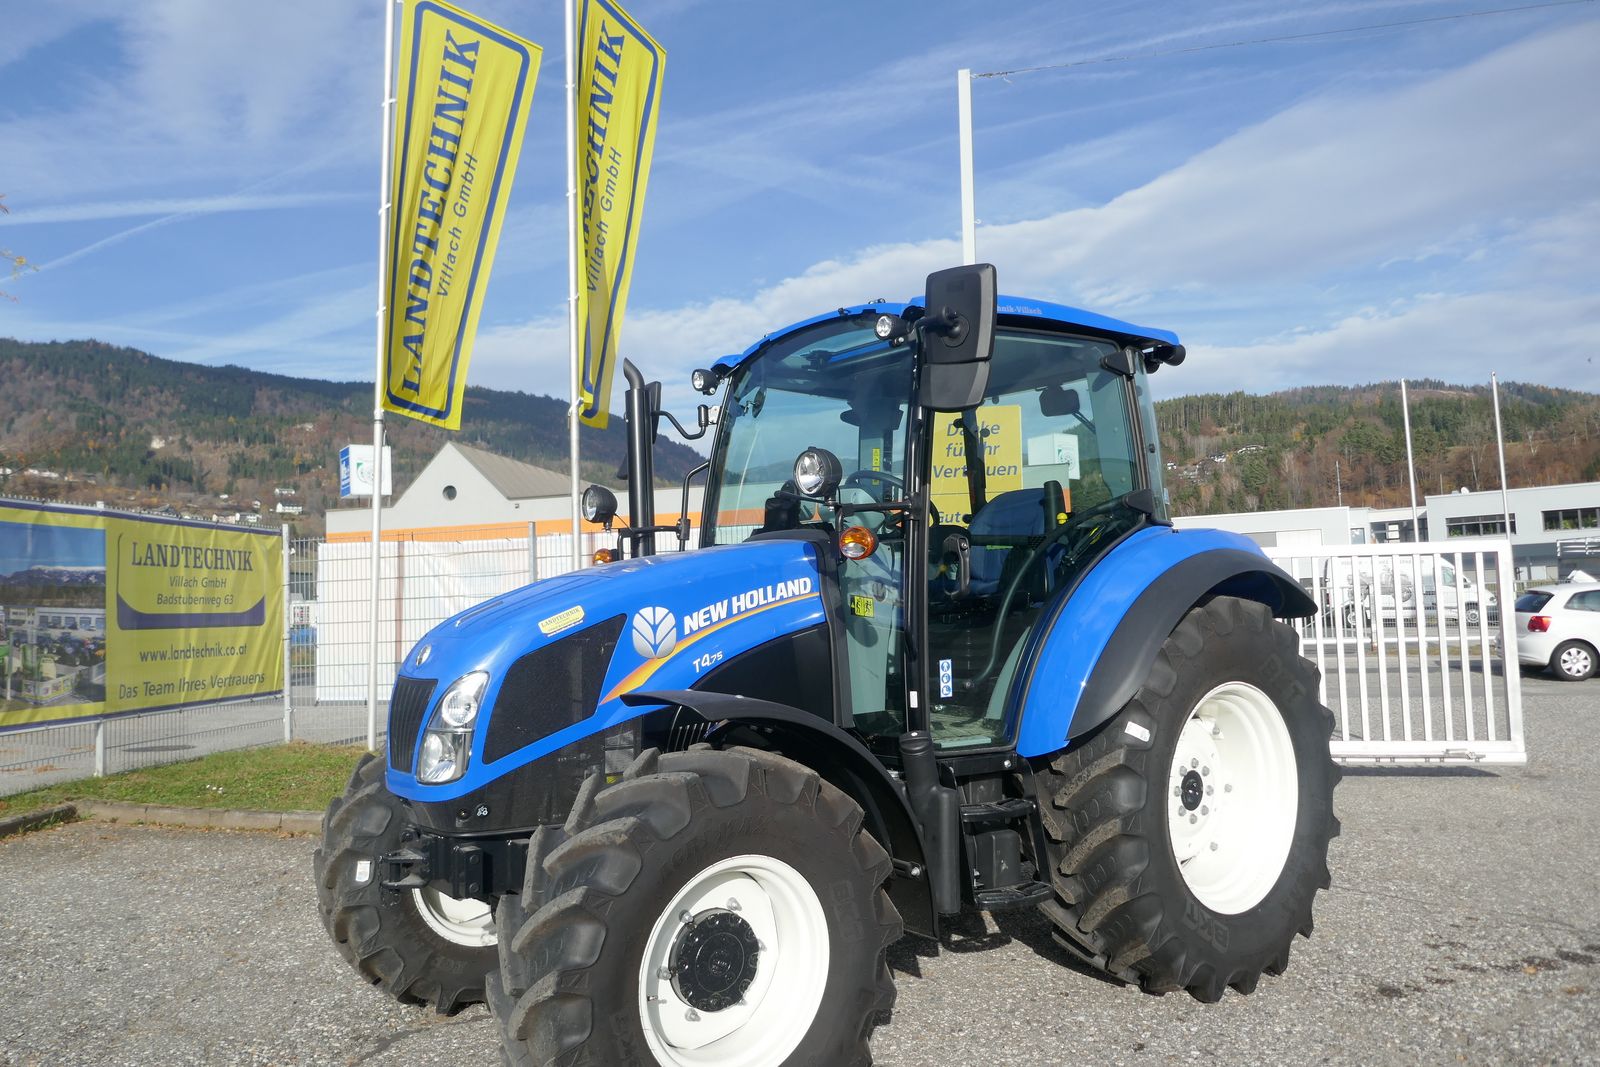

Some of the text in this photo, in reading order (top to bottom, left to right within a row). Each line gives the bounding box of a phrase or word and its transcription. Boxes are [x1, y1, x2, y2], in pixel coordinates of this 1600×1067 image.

[402, 29, 480, 396] LANDTECHNIK
[437, 152, 479, 297] Villach GmbH
[586, 147, 622, 291] Villach GmbH
[946, 420, 1000, 437] Dake
[946, 442, 969, 457] fü
[933, 464, 1018, 478] Vertuen
[131, 542, 254, 572] LANDTECHNIK
[169, 576, 227, 588] Villach GmbH
[157, 593, 234, 607] Badstubenweg 63
[683, 577, 812, 635] NEW HOLLAND
[139, 642, 247, 663] www.landtechnik.co.at
[119, 672, 265, 700] Das Team Ihres Vertrauens
